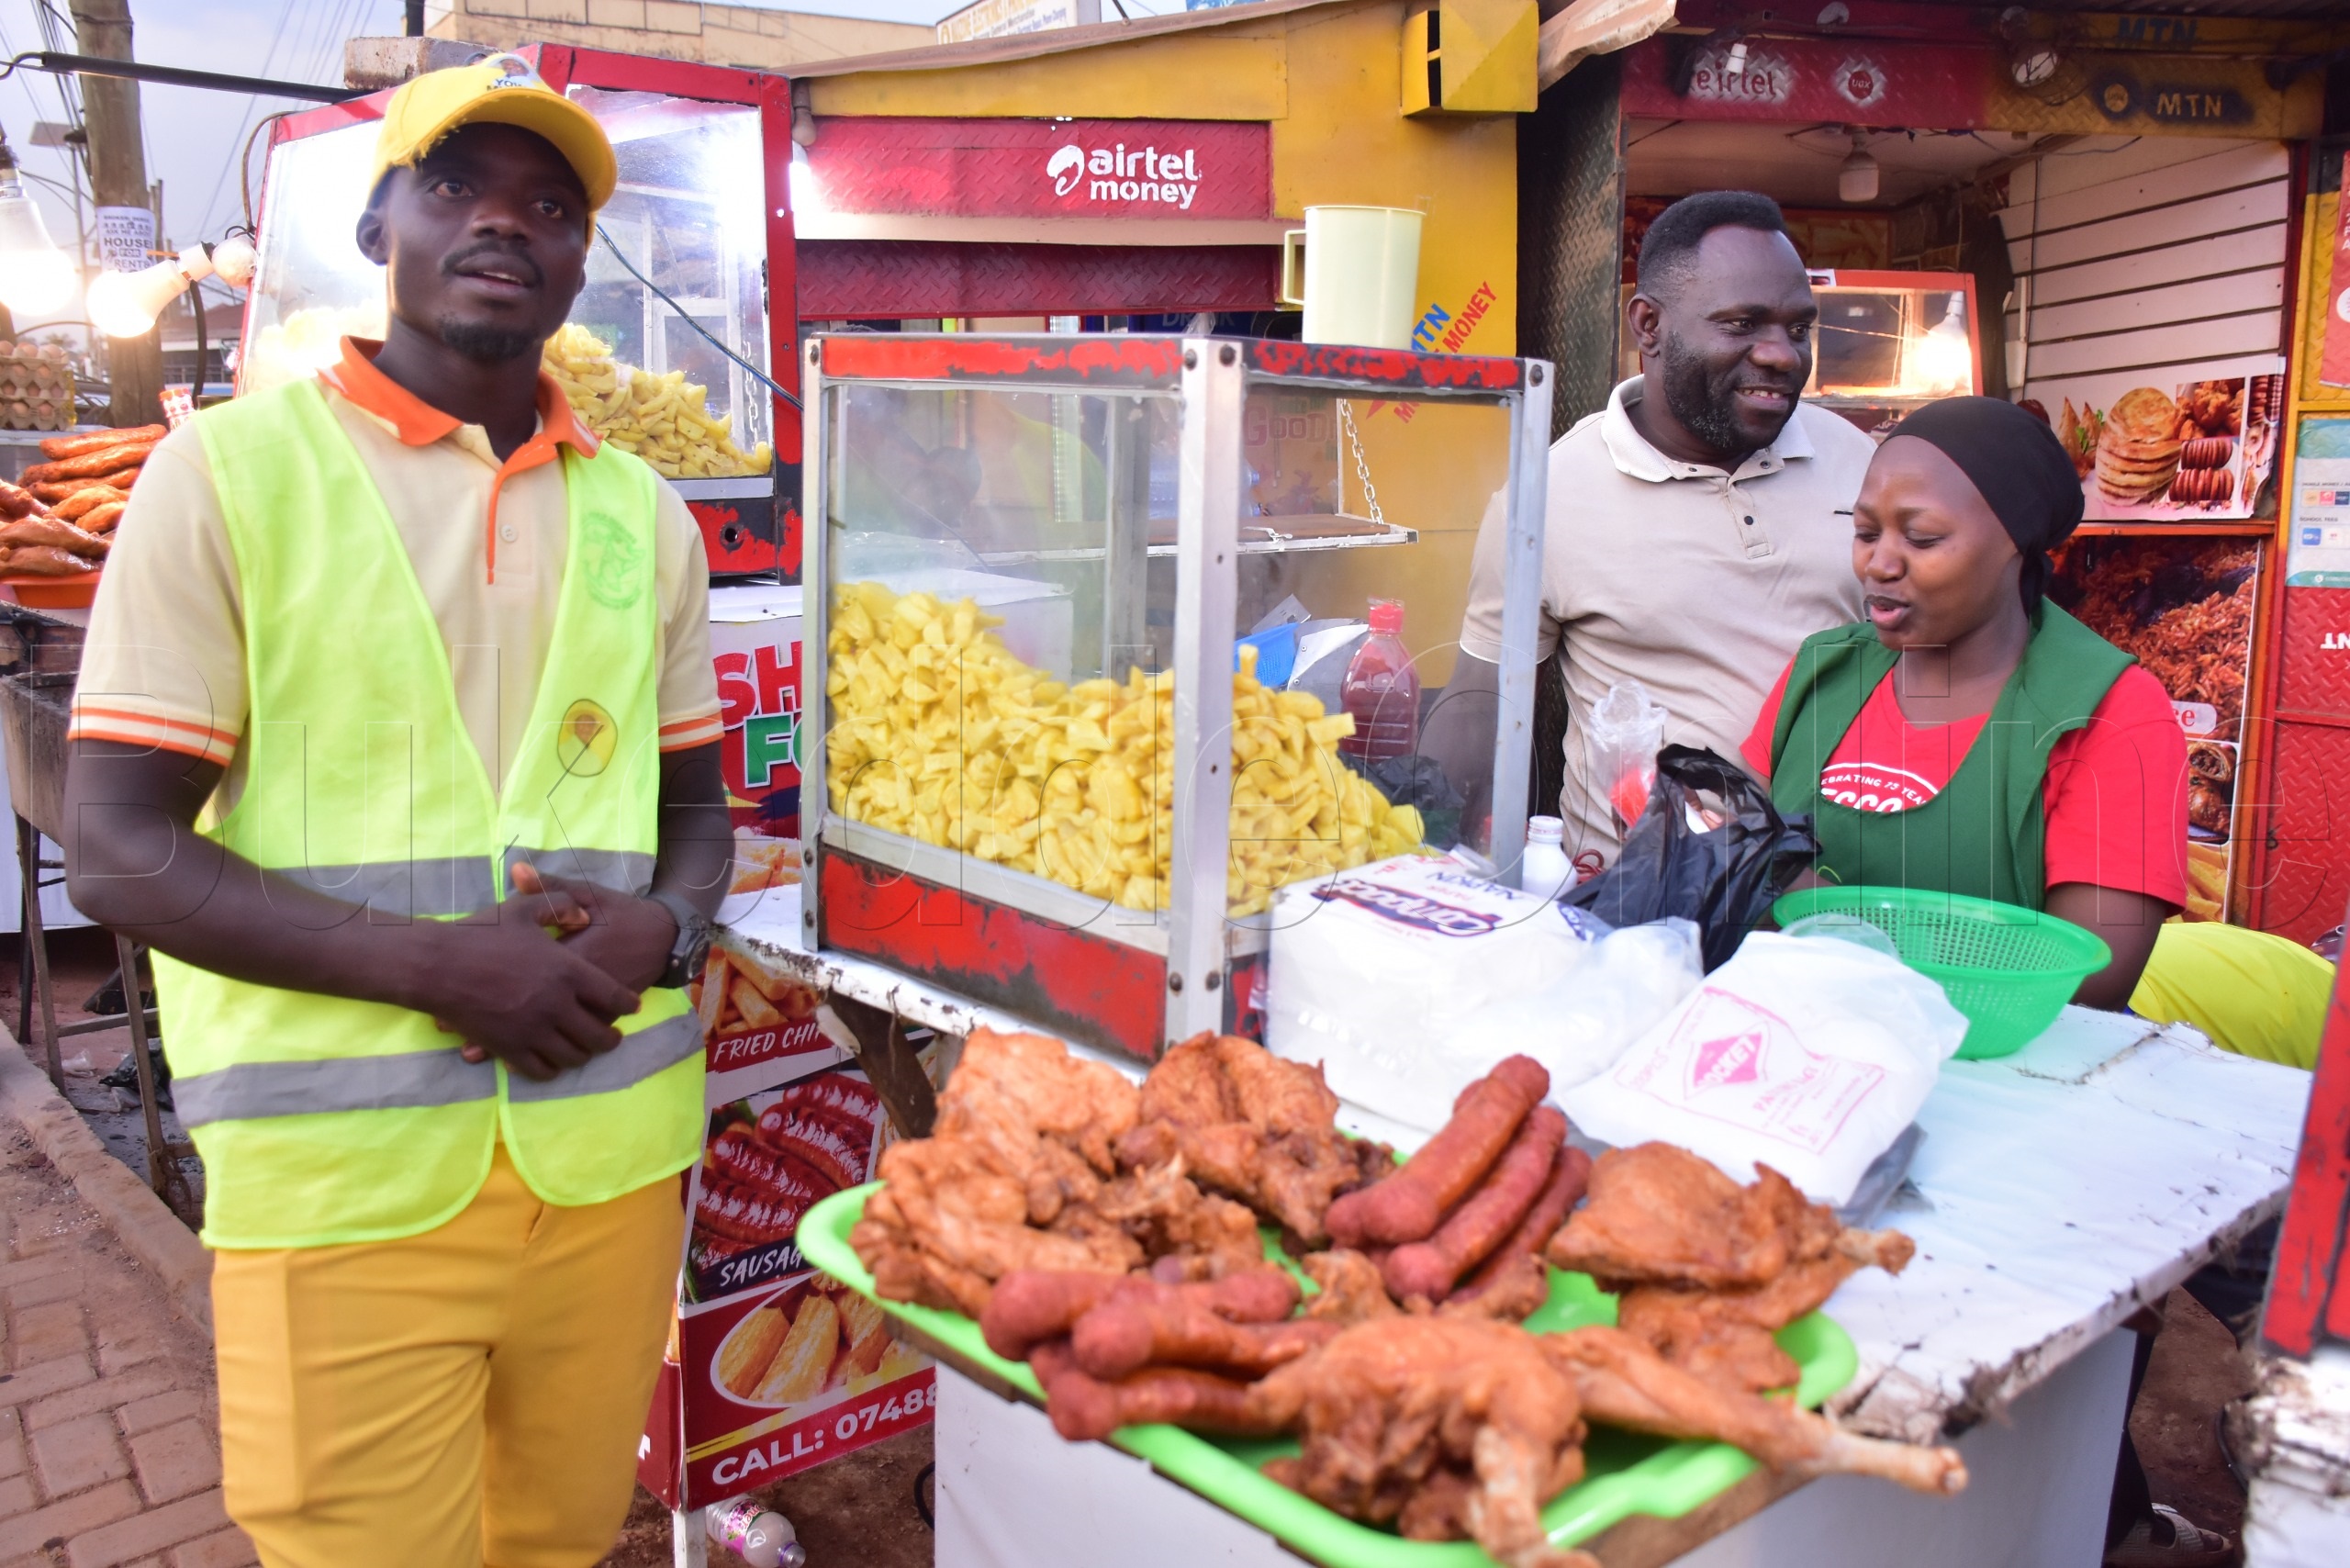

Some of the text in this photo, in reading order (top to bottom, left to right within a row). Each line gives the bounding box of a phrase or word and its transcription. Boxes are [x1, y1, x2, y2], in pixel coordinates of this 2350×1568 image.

[2118, 17, 2198, 42] MTN
[2157, 93, 2222, 118] MTN
[1088, 143, 1200, 181] airtel
[1089, 179, 1197, 210] money
[1442, 280, 1497, 353] MONEY
[714, 1022, 822, 1064] FRIED CHI
[1700, 1036, 1756, 1086] OCKET
[711, 1428, 824, 1485] CALL:
[834, 1382, 936, 1439] 07488
